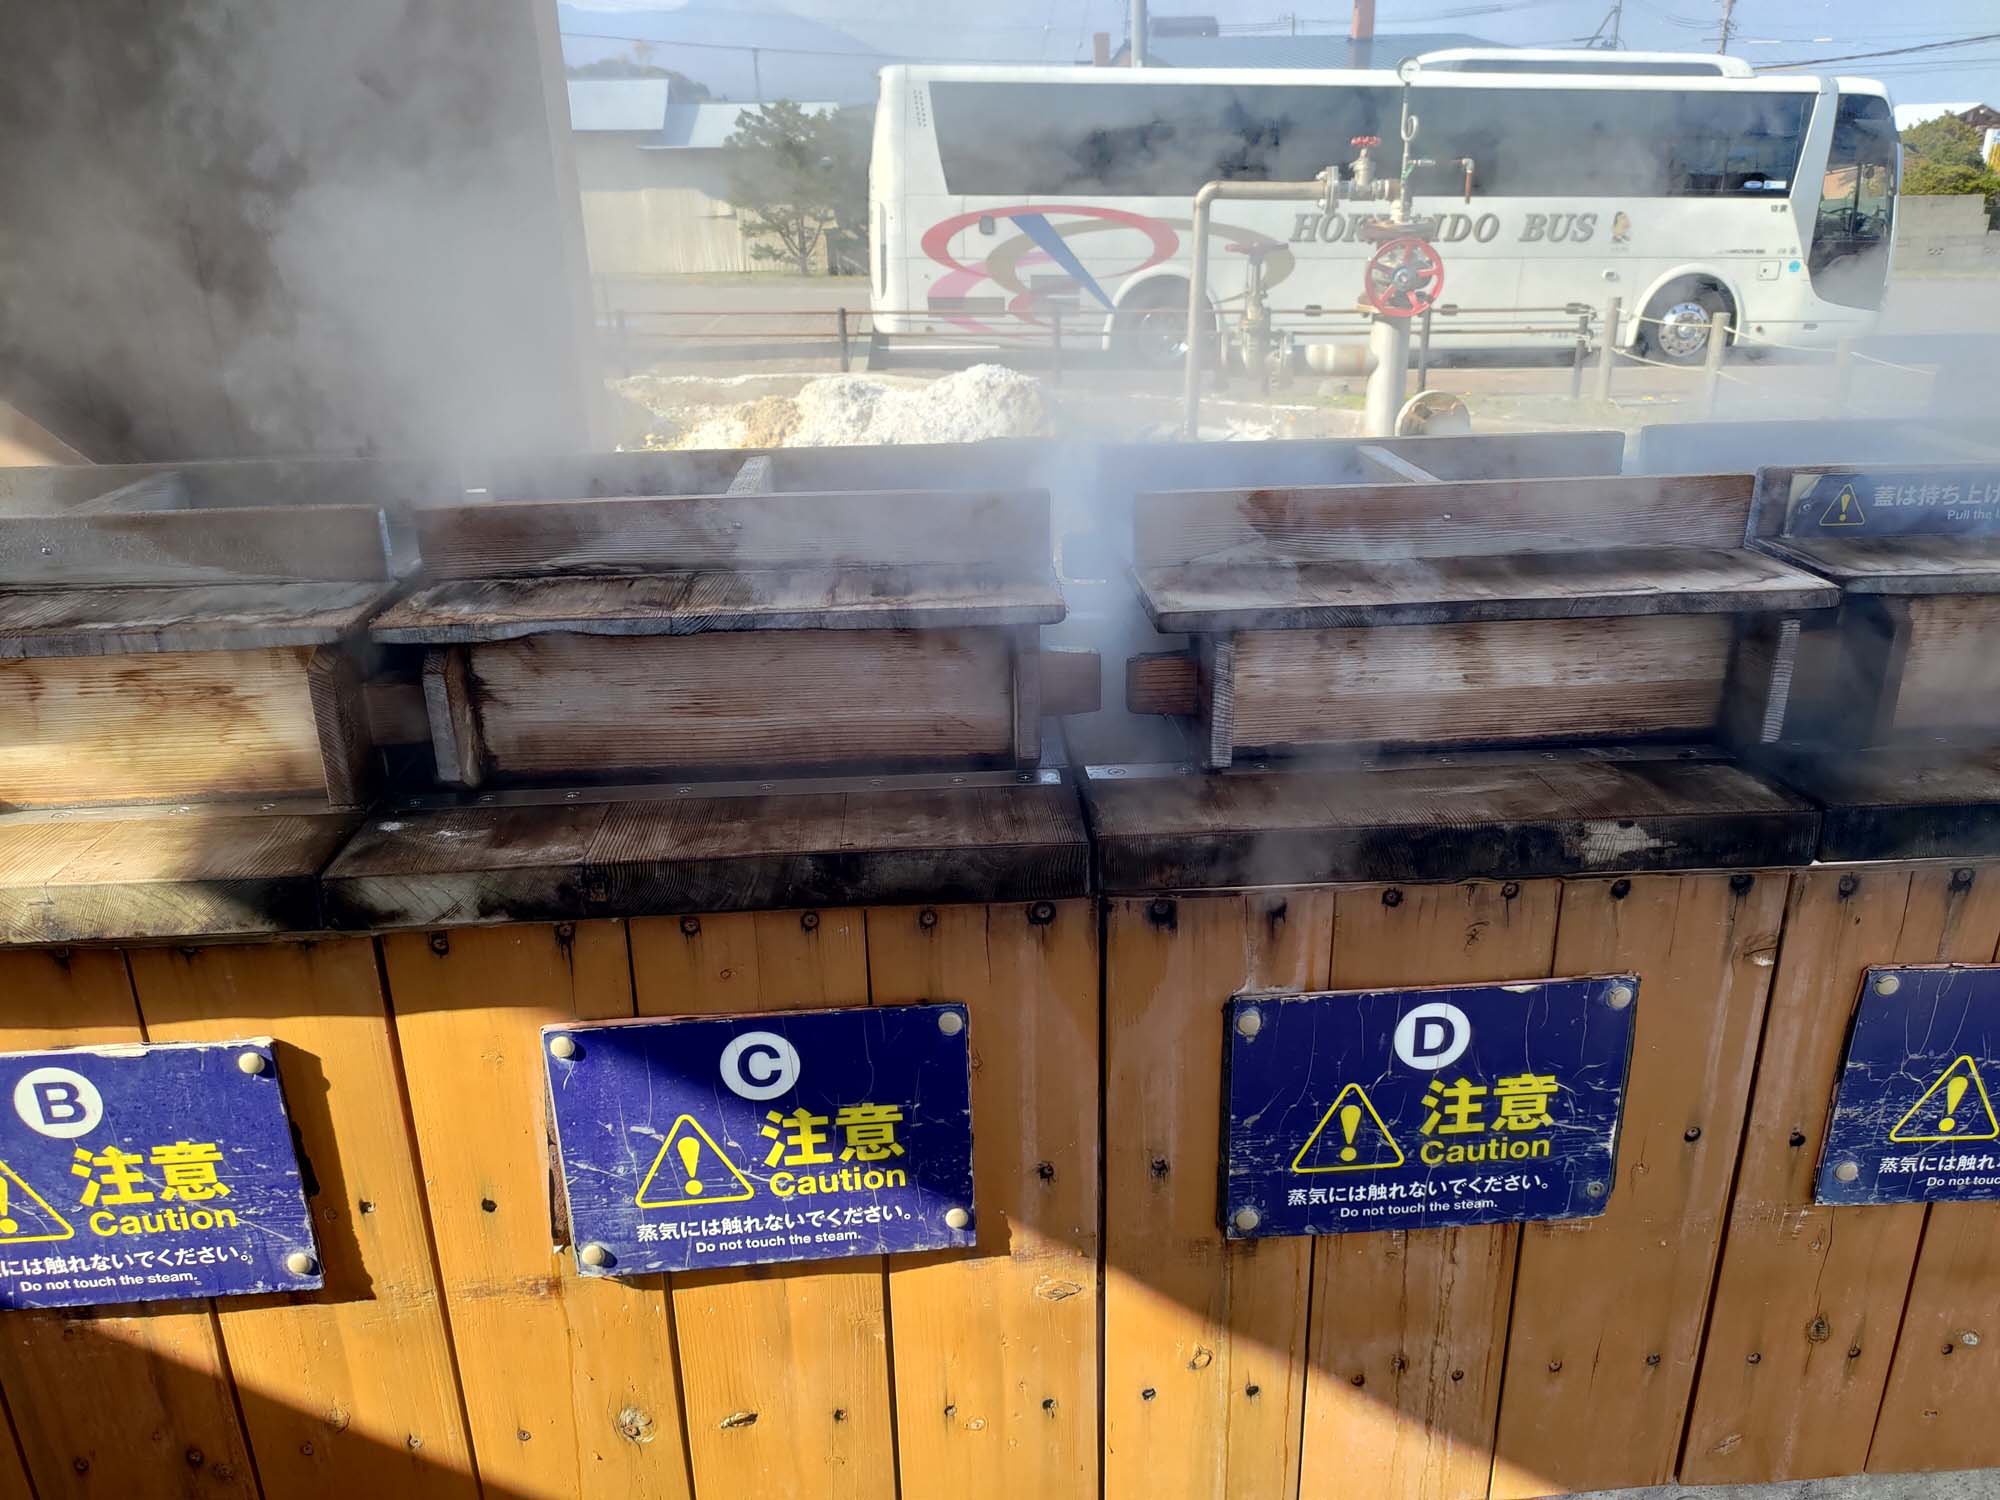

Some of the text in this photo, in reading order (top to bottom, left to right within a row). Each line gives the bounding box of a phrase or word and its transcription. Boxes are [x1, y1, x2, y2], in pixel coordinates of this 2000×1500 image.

[1289, 213, 1600, 243] HOKIDO BUS
[1947, 510, 1970, 520] Pull
[1413, 1017, 1455, 1057] D
[737, 1044, 782, 1087] C
[32, 1081, 87, 1125] B
[1419, 1073, 1559, 1137] 注意
[760, 1102, 905, 1168] 注意
[1420, 1137, 1550, 1165] Caution
[71, 1141, 231, 1207] 注意
[1879, 1154, 2000, 1173] 蒸気には触れ
[769, 1165, 906, 1198] Caution
[1287, 1173, 1549, 1206] 蒸気には触れないでください。
[1927, 1177, 1945, 1186] Do
[1948, 1177, 1970, 1186] not
[89, 1207, 237, 1237] Caution
[636, 1204, 912, 1243] 蒸気には触れないでください。
[1340, 1199, 1498, 1218] Do not touch the steam.
[695, 1231, 862, 1253] Do not touch the steam.
[0, 1245, 250, 1277] には触れないでください。
[20, 1270, 198, 1292] Do not touch the steam.
